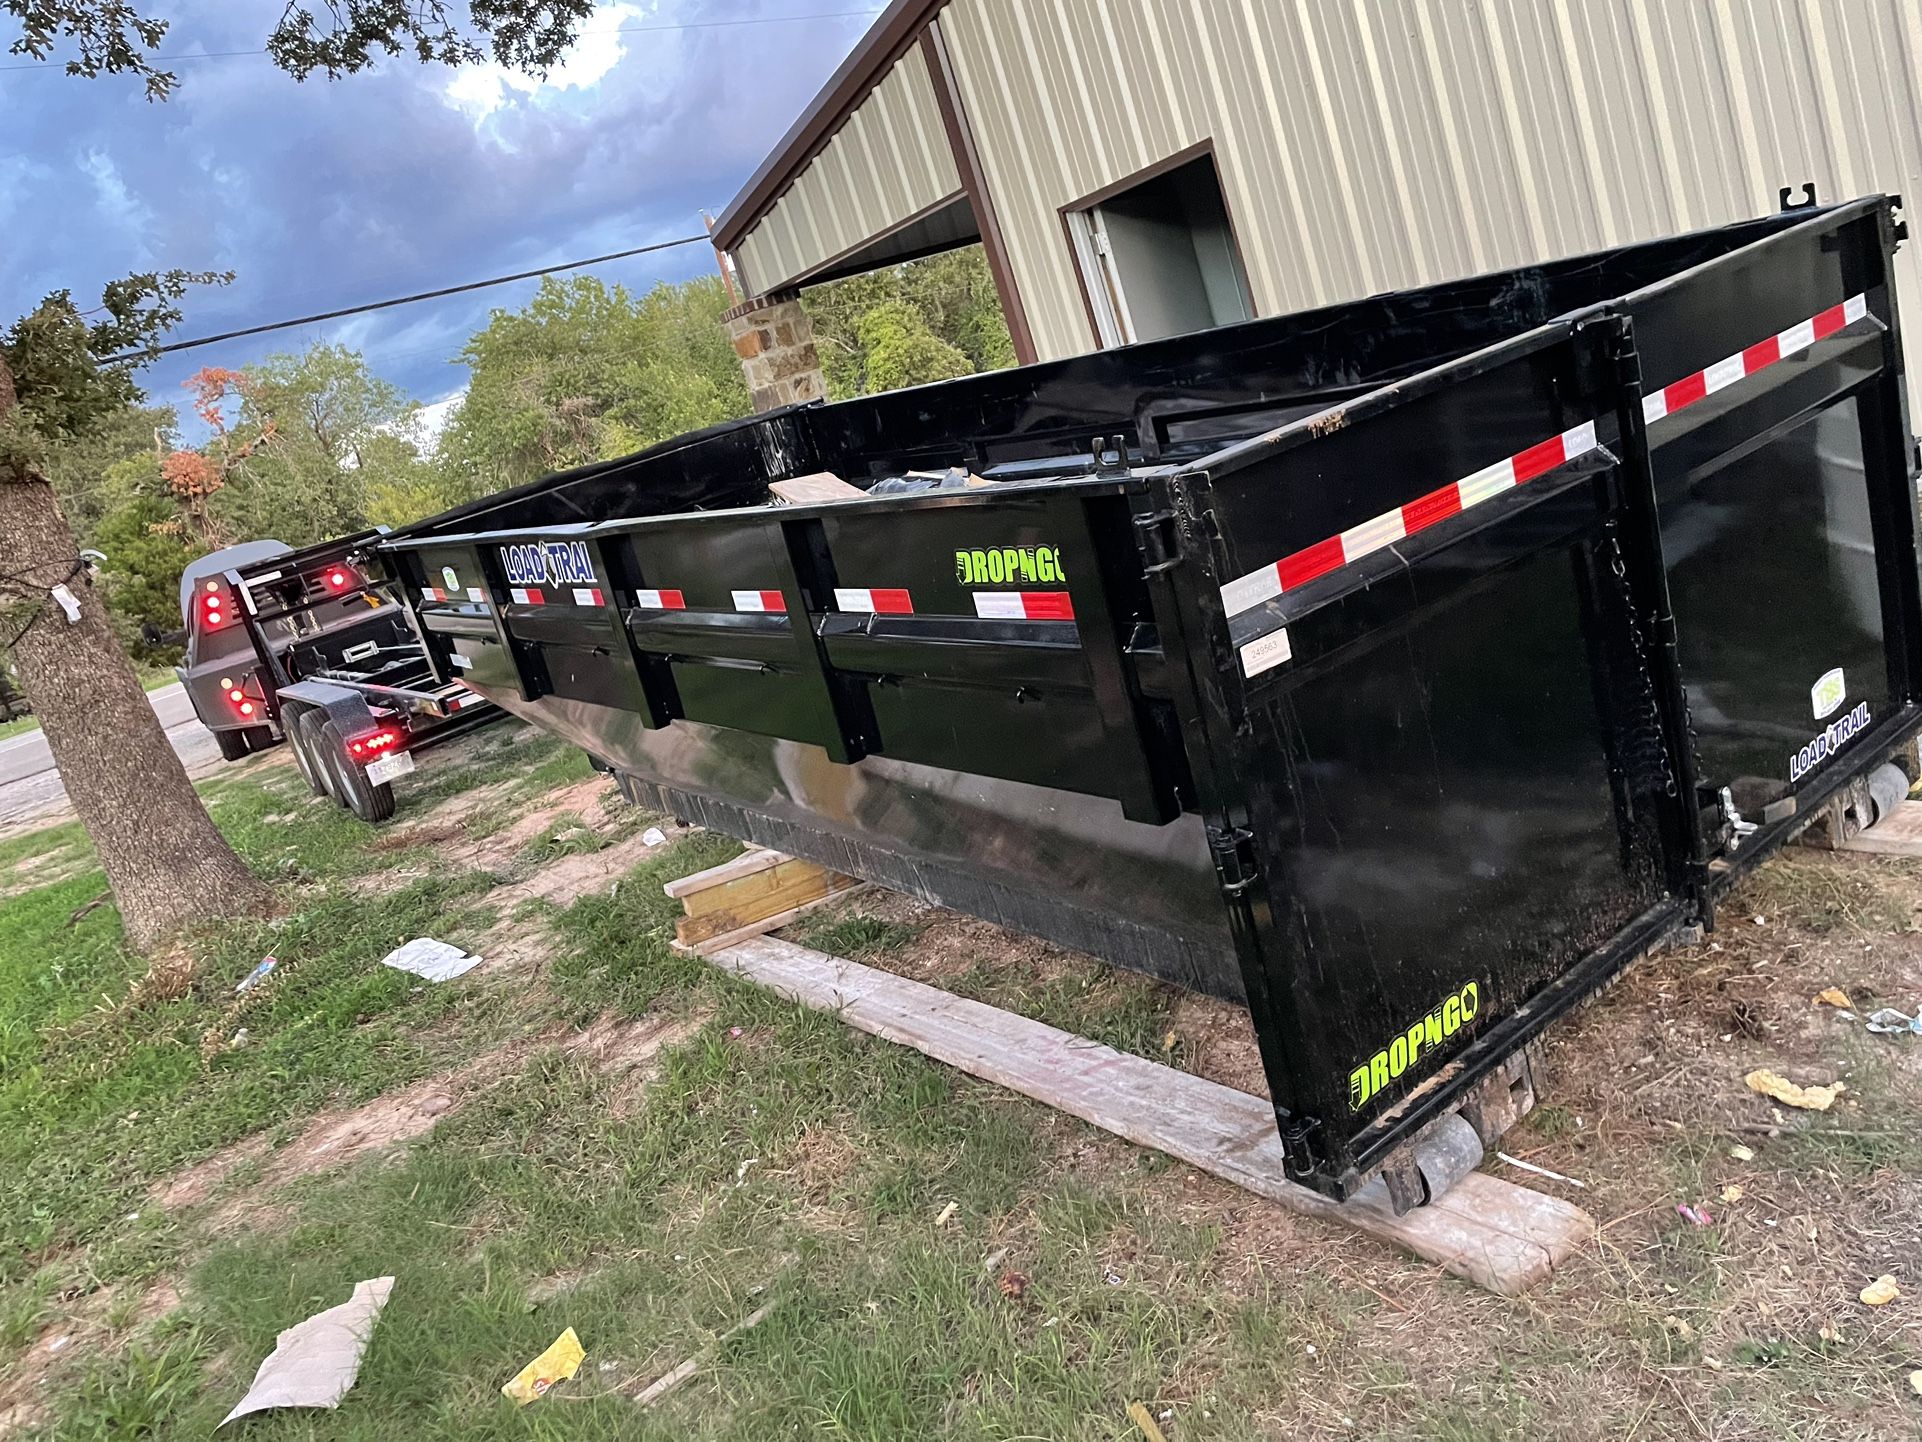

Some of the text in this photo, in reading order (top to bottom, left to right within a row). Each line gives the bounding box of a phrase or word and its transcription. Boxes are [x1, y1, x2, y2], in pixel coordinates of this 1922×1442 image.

[500, 546, 545, 584] LOAD
[1790, 732, 1828, 782] LOAD
[1832, 701, 1870, 747] TRAIL
[1349, 981, 1478, 1112] DROPNGO
